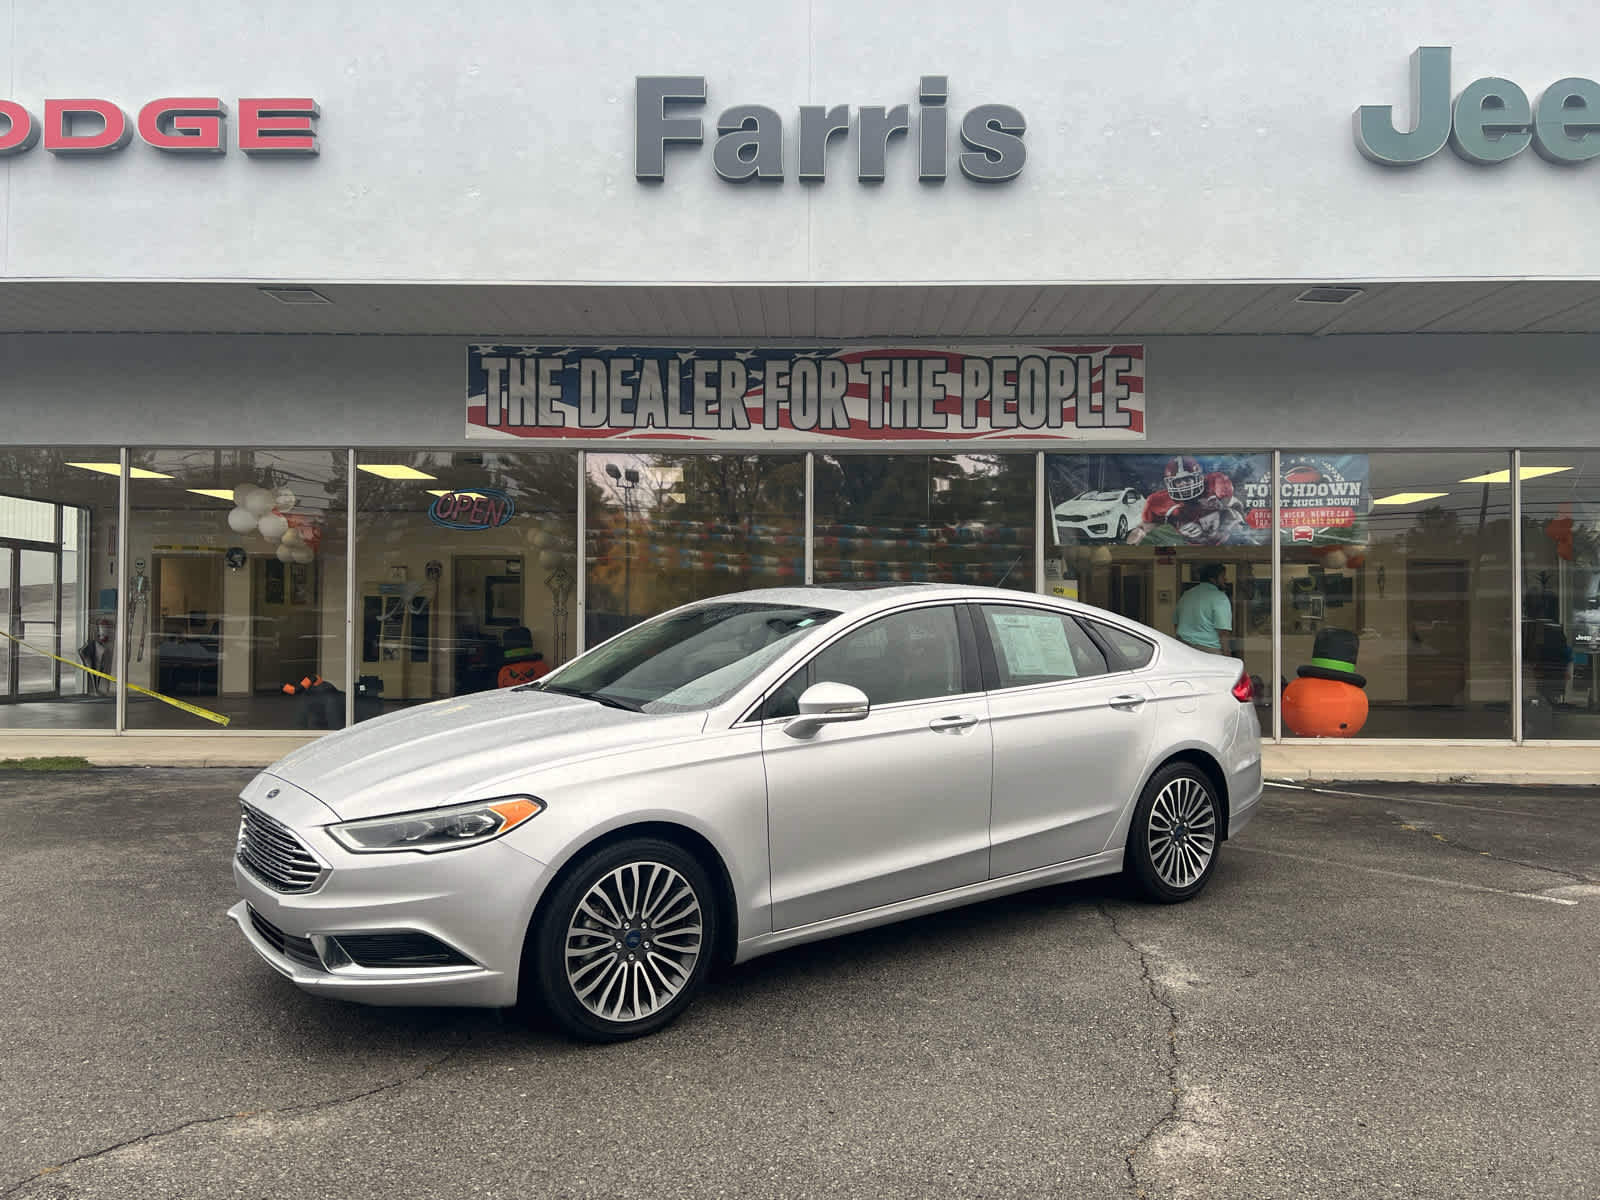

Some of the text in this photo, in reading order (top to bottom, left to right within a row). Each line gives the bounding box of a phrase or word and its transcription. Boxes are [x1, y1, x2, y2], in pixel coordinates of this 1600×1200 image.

[635, 75, 1027, 183] Farris
[480, 355, 1133, 431] THE DEALER FOR THE PEOPLE
[1244, 482, 1361, 497] TOCHDOWN
[1246, 499, 1266, 508] FOR
[1292, 498, 1323, 507] MUCH
[436, 492, 504, 526] OPEN
